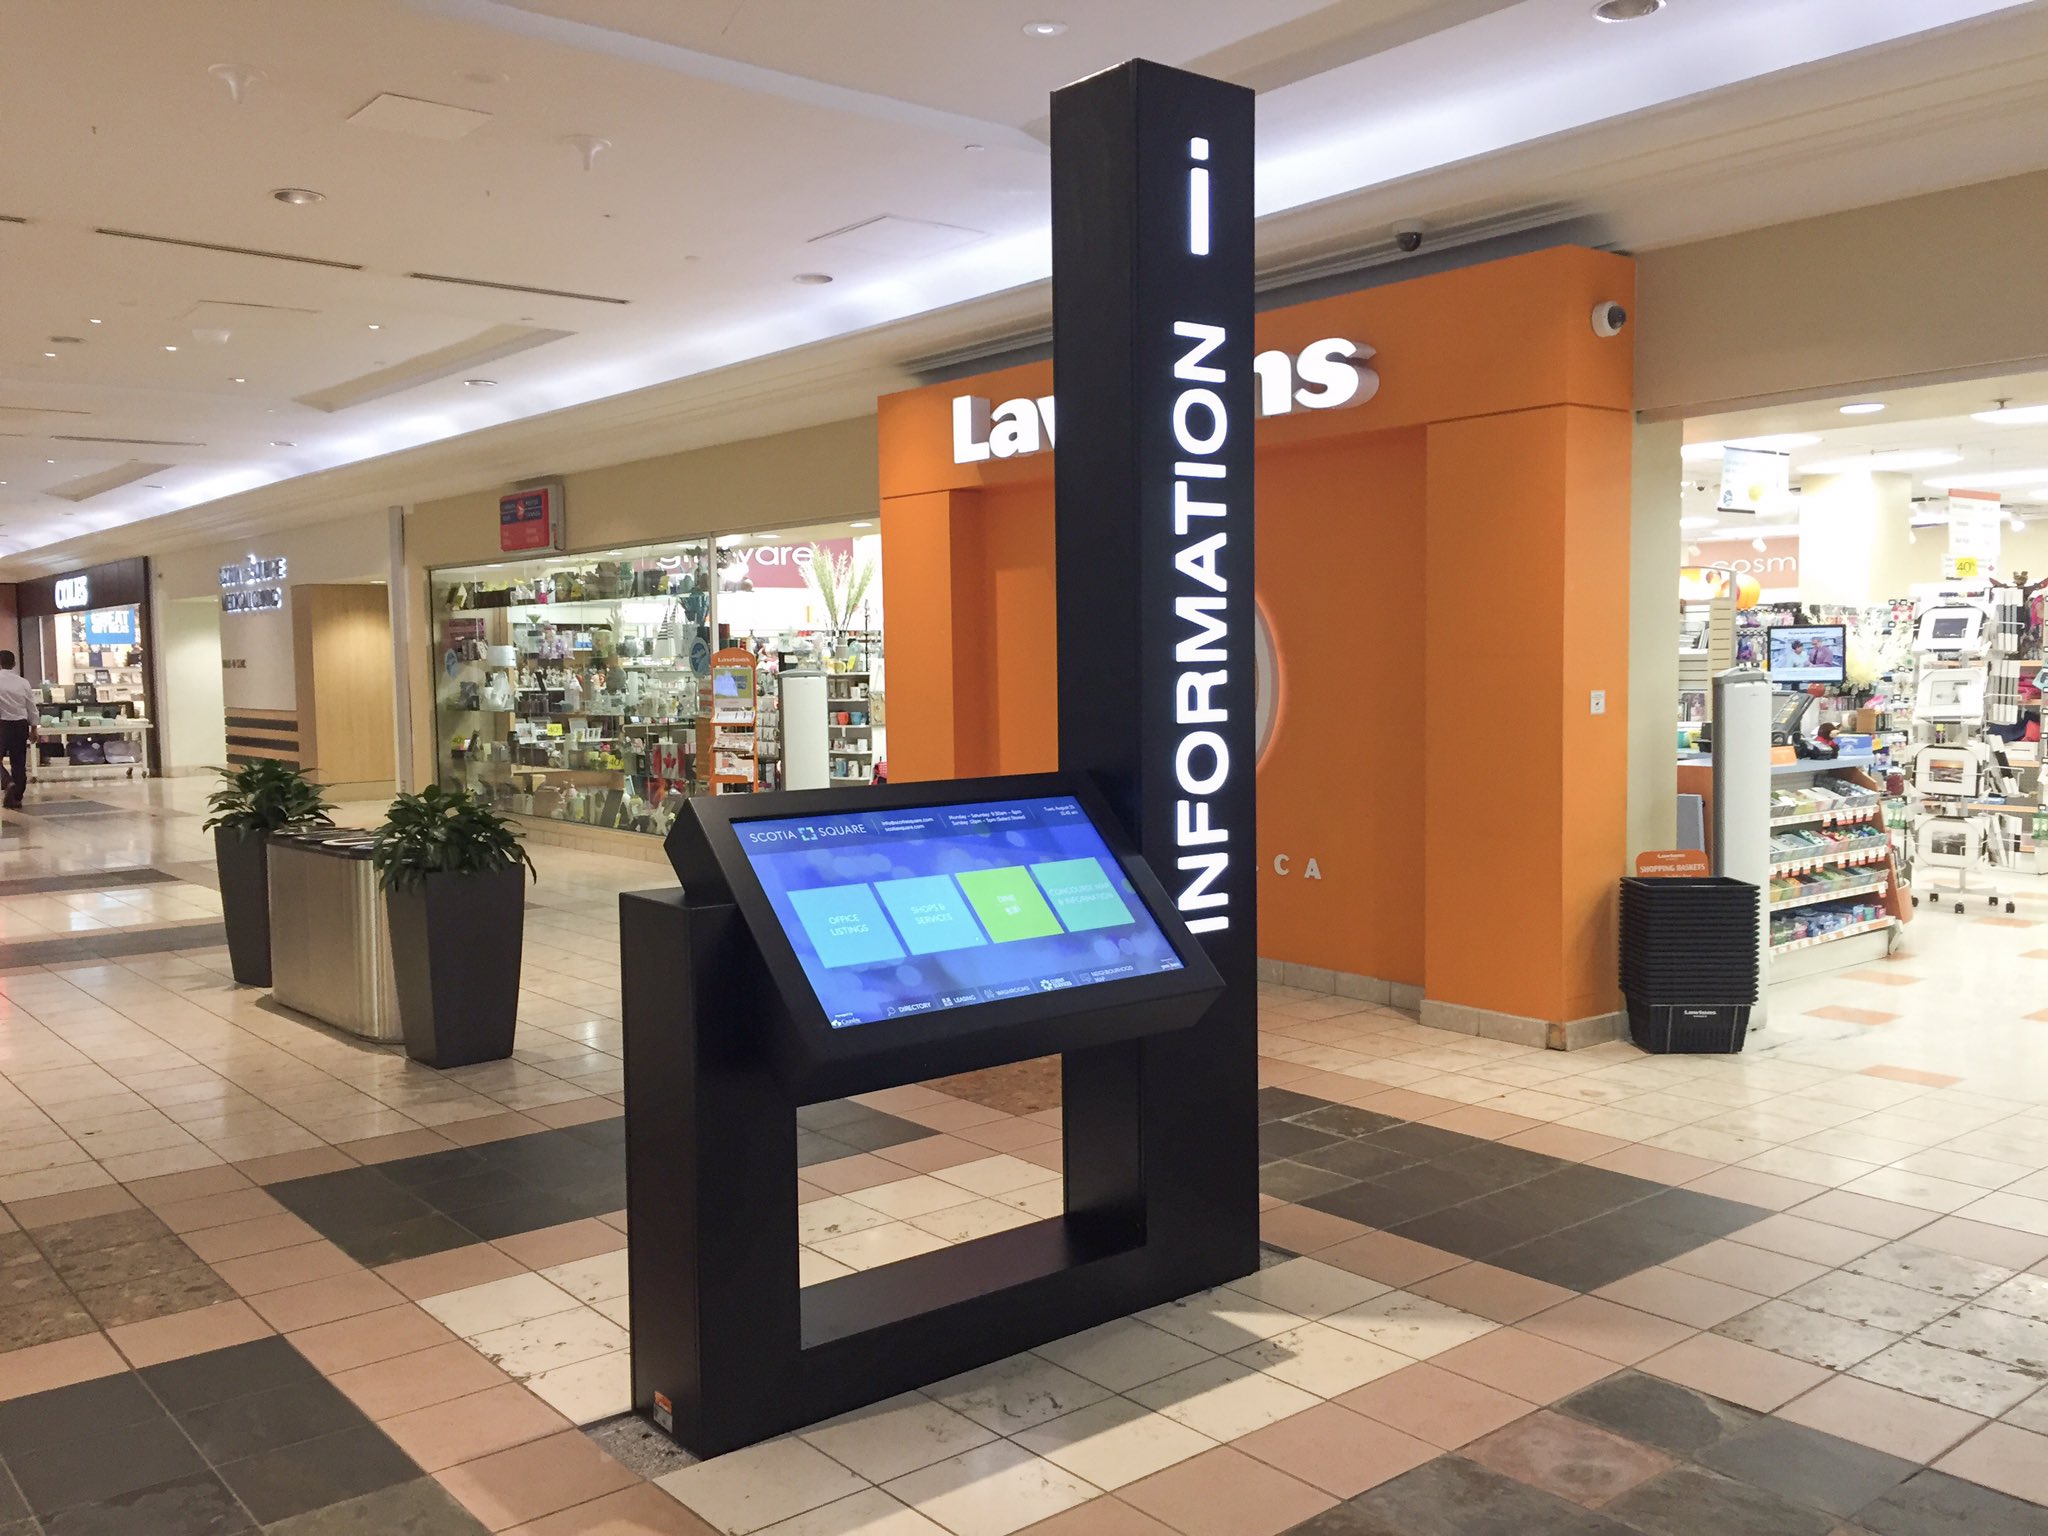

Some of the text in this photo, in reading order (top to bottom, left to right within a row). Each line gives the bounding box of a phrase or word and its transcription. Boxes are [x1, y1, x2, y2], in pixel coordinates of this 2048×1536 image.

[1172, 320, 1231, 935] INFORMATION
[749, 823, 868, 844] SCOTIA SQUARE
[1640, 863, 1706, 874] SHOPPING BASKETS
[910, 903, 939, 915] SHOPS
[828, 913, 860, 925] OFFICE
[914, 912, 953, 925] SERVICES
[830, 924, 870, 937] LISTINGS
[953, 993, 977, 1004] LEASING
[897, 1001, 932, 1013] DIRECTORY
